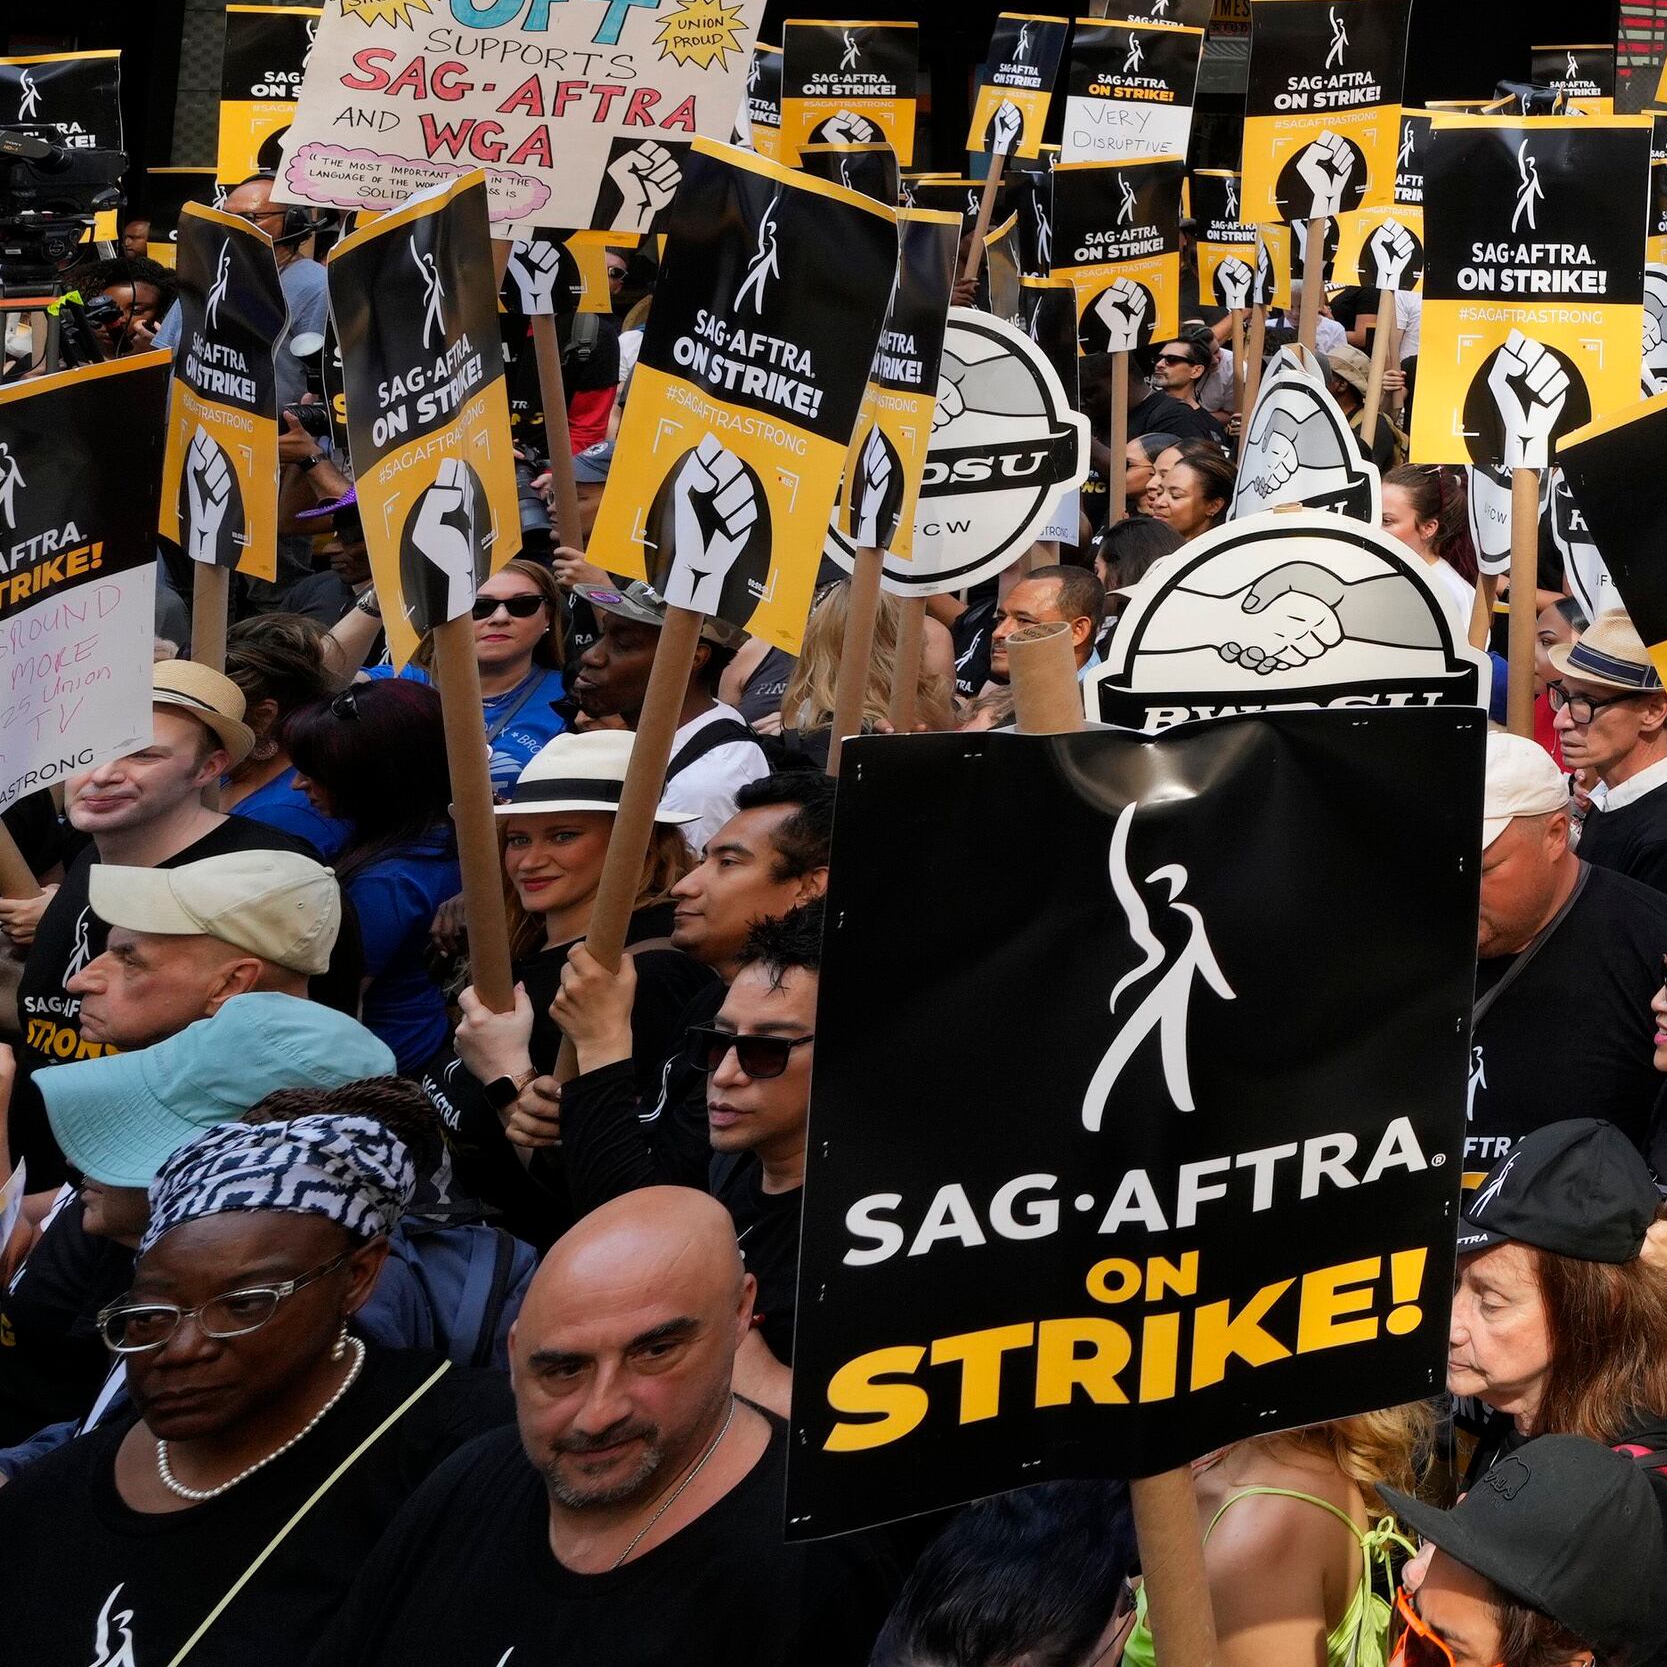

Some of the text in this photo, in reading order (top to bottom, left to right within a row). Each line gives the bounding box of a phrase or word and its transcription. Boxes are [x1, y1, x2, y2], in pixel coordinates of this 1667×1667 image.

[672, 31, 724, 50] PROUD
[425, 28, 638, 81] SUPPORTS
[802, 83, 896, 96] ON STRIKE!
[1274, 85, 1381, 110] ON STRIKE!
[1082, 104, 1152, 134] VERY
[333, 106, 554, 169] AND WGA
[1072, 129, 1173, 154] DISRUPTIVE
[309, 169, 365, 182] LANGUAGE
[350, 161, 381, 172] MOST
[391, 166, 450, 179] IMPORTANT
[1456, 269, 1608, 294] ON STRIKE!
[673, 335, 823, 419] ON STRIKE!
[1085, 1249, 1200, 1304] ON
[823, 1247, 1429, 1453] STRIKE!
